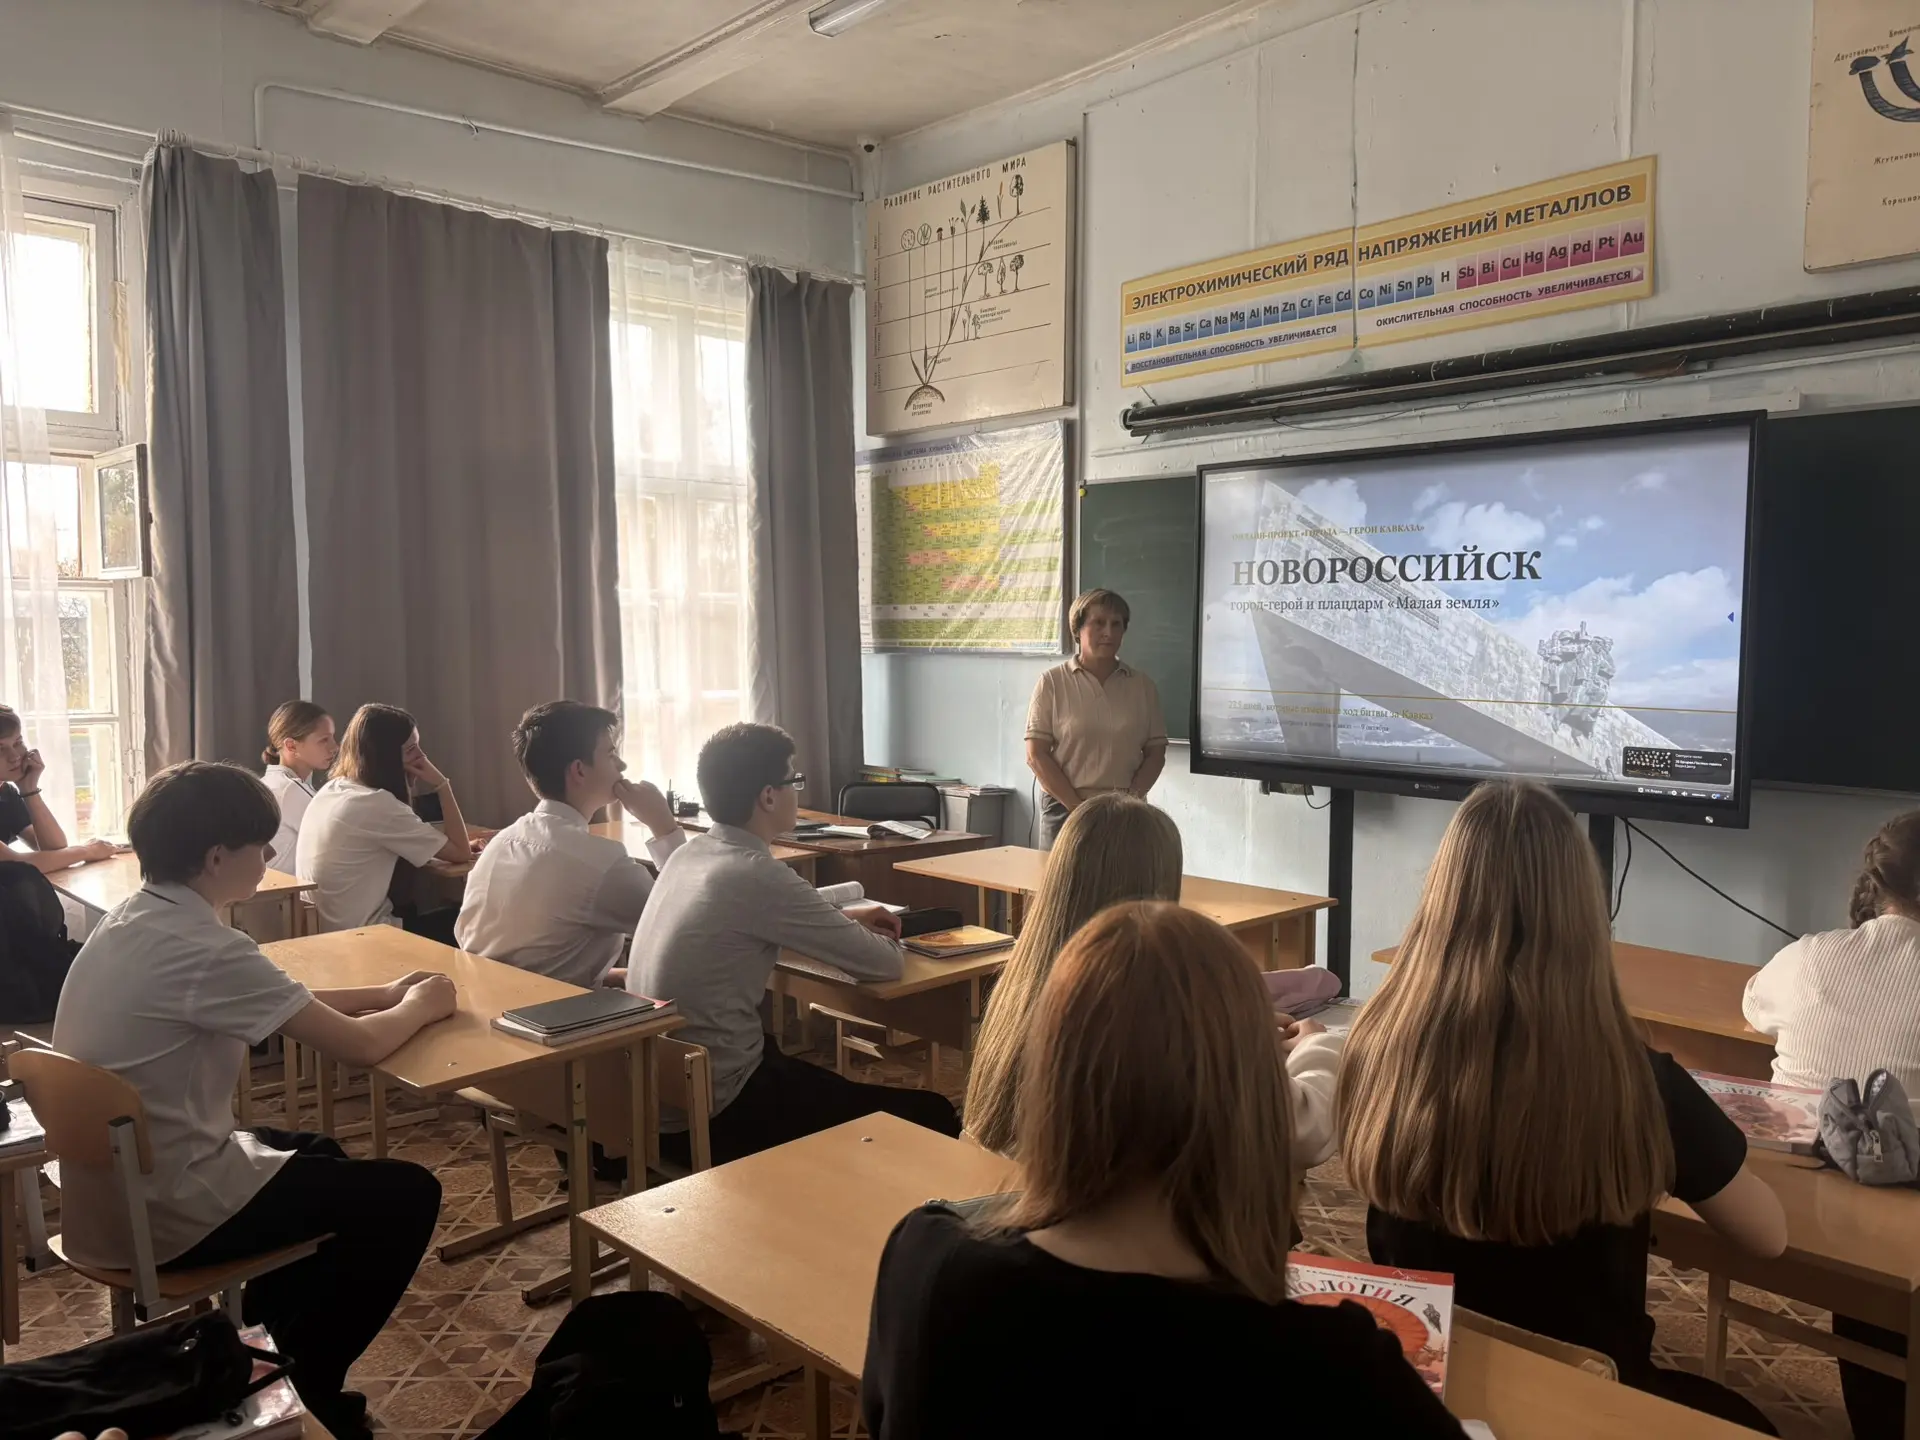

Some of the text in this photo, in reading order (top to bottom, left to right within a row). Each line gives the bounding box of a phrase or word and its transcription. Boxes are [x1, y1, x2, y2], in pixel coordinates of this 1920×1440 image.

[883, 156, 1027, 210] РАЗВИТИЕ РАСТИТЕЛЬНОГО МИРА
[1132, 184, 1632, 310] ЭЛЕКТРОХИМИЧЕСКИЙ РЯД НАПРЯЖЕНИЙ МЕТАЛЛОВ
[1127, 231, 1644, 344] Li Rb K Ba Sr Ca Na Mg Al Mn Zn Cr Fe Cd Co Ni Sn Pb H Sb Bi Cu Hg Ag Pd Pt Au
[1376, 270, 1631, 328] ОКИСЛИТЕЛЬНАЯ СПОСОБНОСТЬ УВЕЛИЧИВАЕТСЯ
[1131, 325, 1337, 371] ВОССТАНОВИТЕЛЬНАЯ СПОСОБНОСТЬ УВЕЛИЧИВАЕТСЯ
[1380, 524, 1425, 534] КАВКАЗА»
[1231, 544, 1543, 586] НОВОРОССИЙСК
[1230, 597, 1500, 613] город-герой и плацдарм «Малая земля»
[1343, 707, 1358, 718] ход
[1360, 706, 1388, 718] битвы
[1400, 709, 1433, 720] Кавказ
[1288, 1278, 1417, 1307] ОЛОГИЯ
